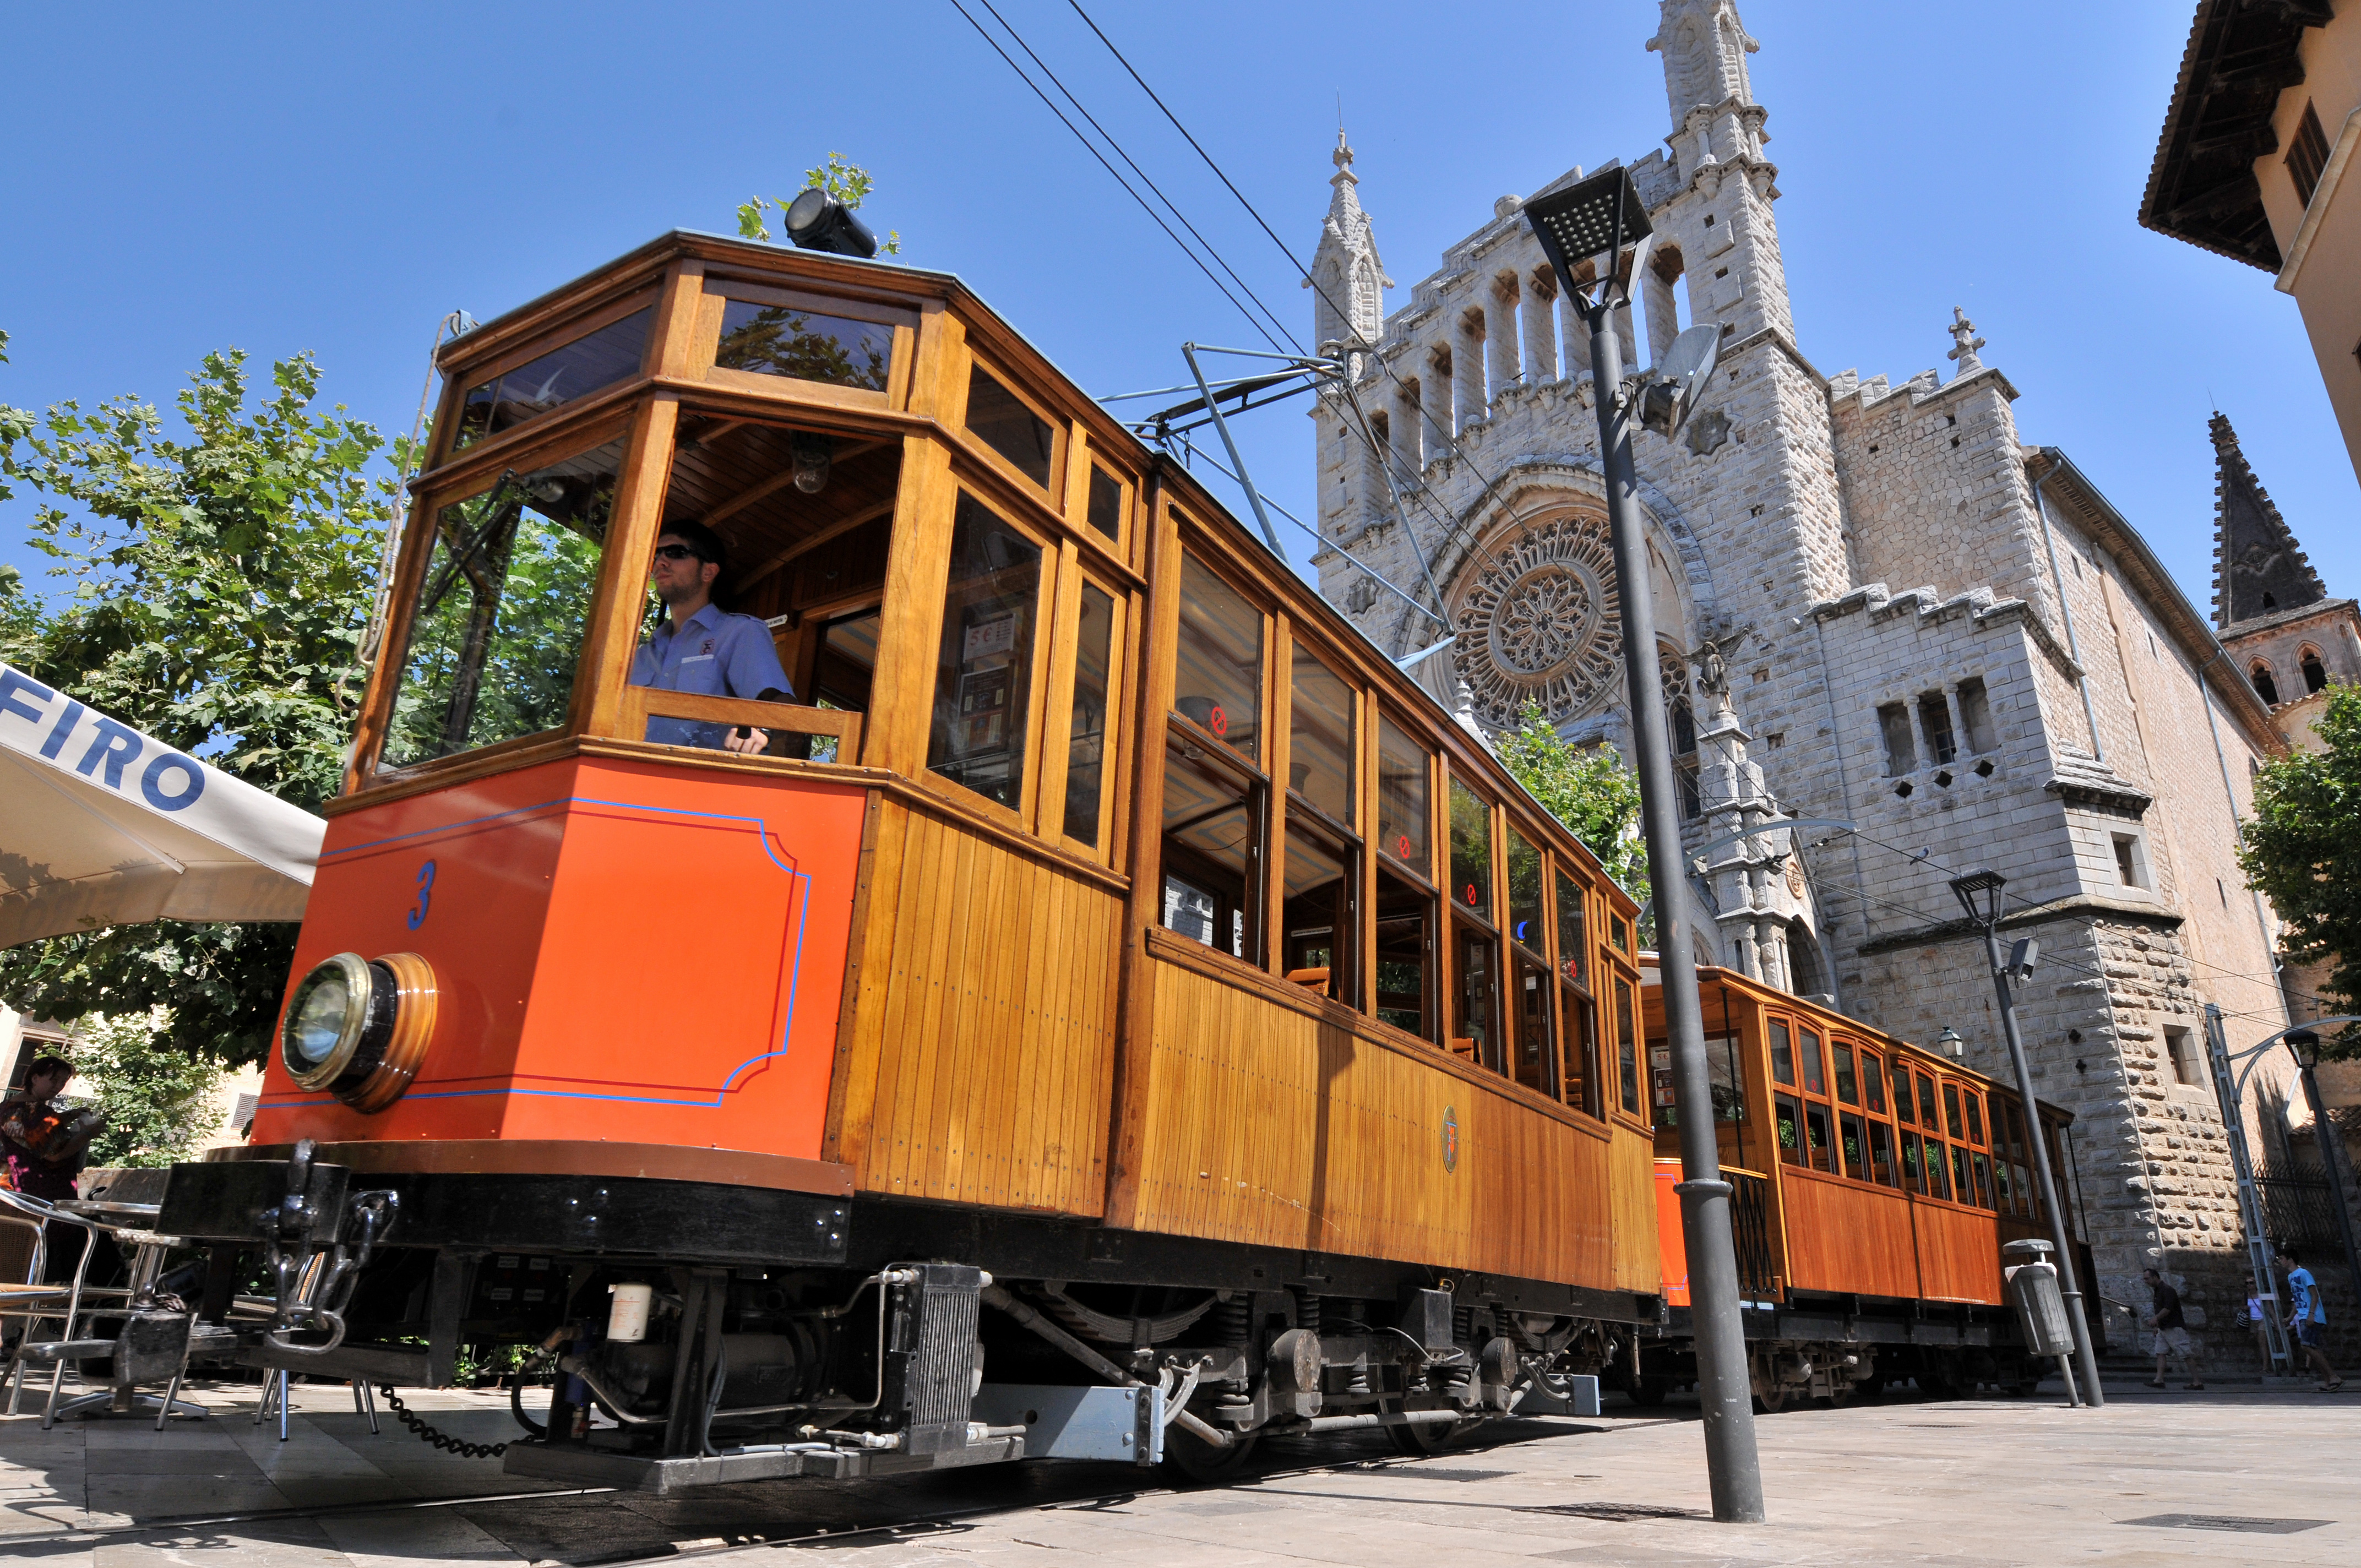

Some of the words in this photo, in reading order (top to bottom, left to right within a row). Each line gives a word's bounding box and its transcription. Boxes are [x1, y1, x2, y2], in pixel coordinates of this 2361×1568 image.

[970, 630, 979, 645] 5
[983, 627, 992, 641] €
[407, 859, 436, 931] 3
